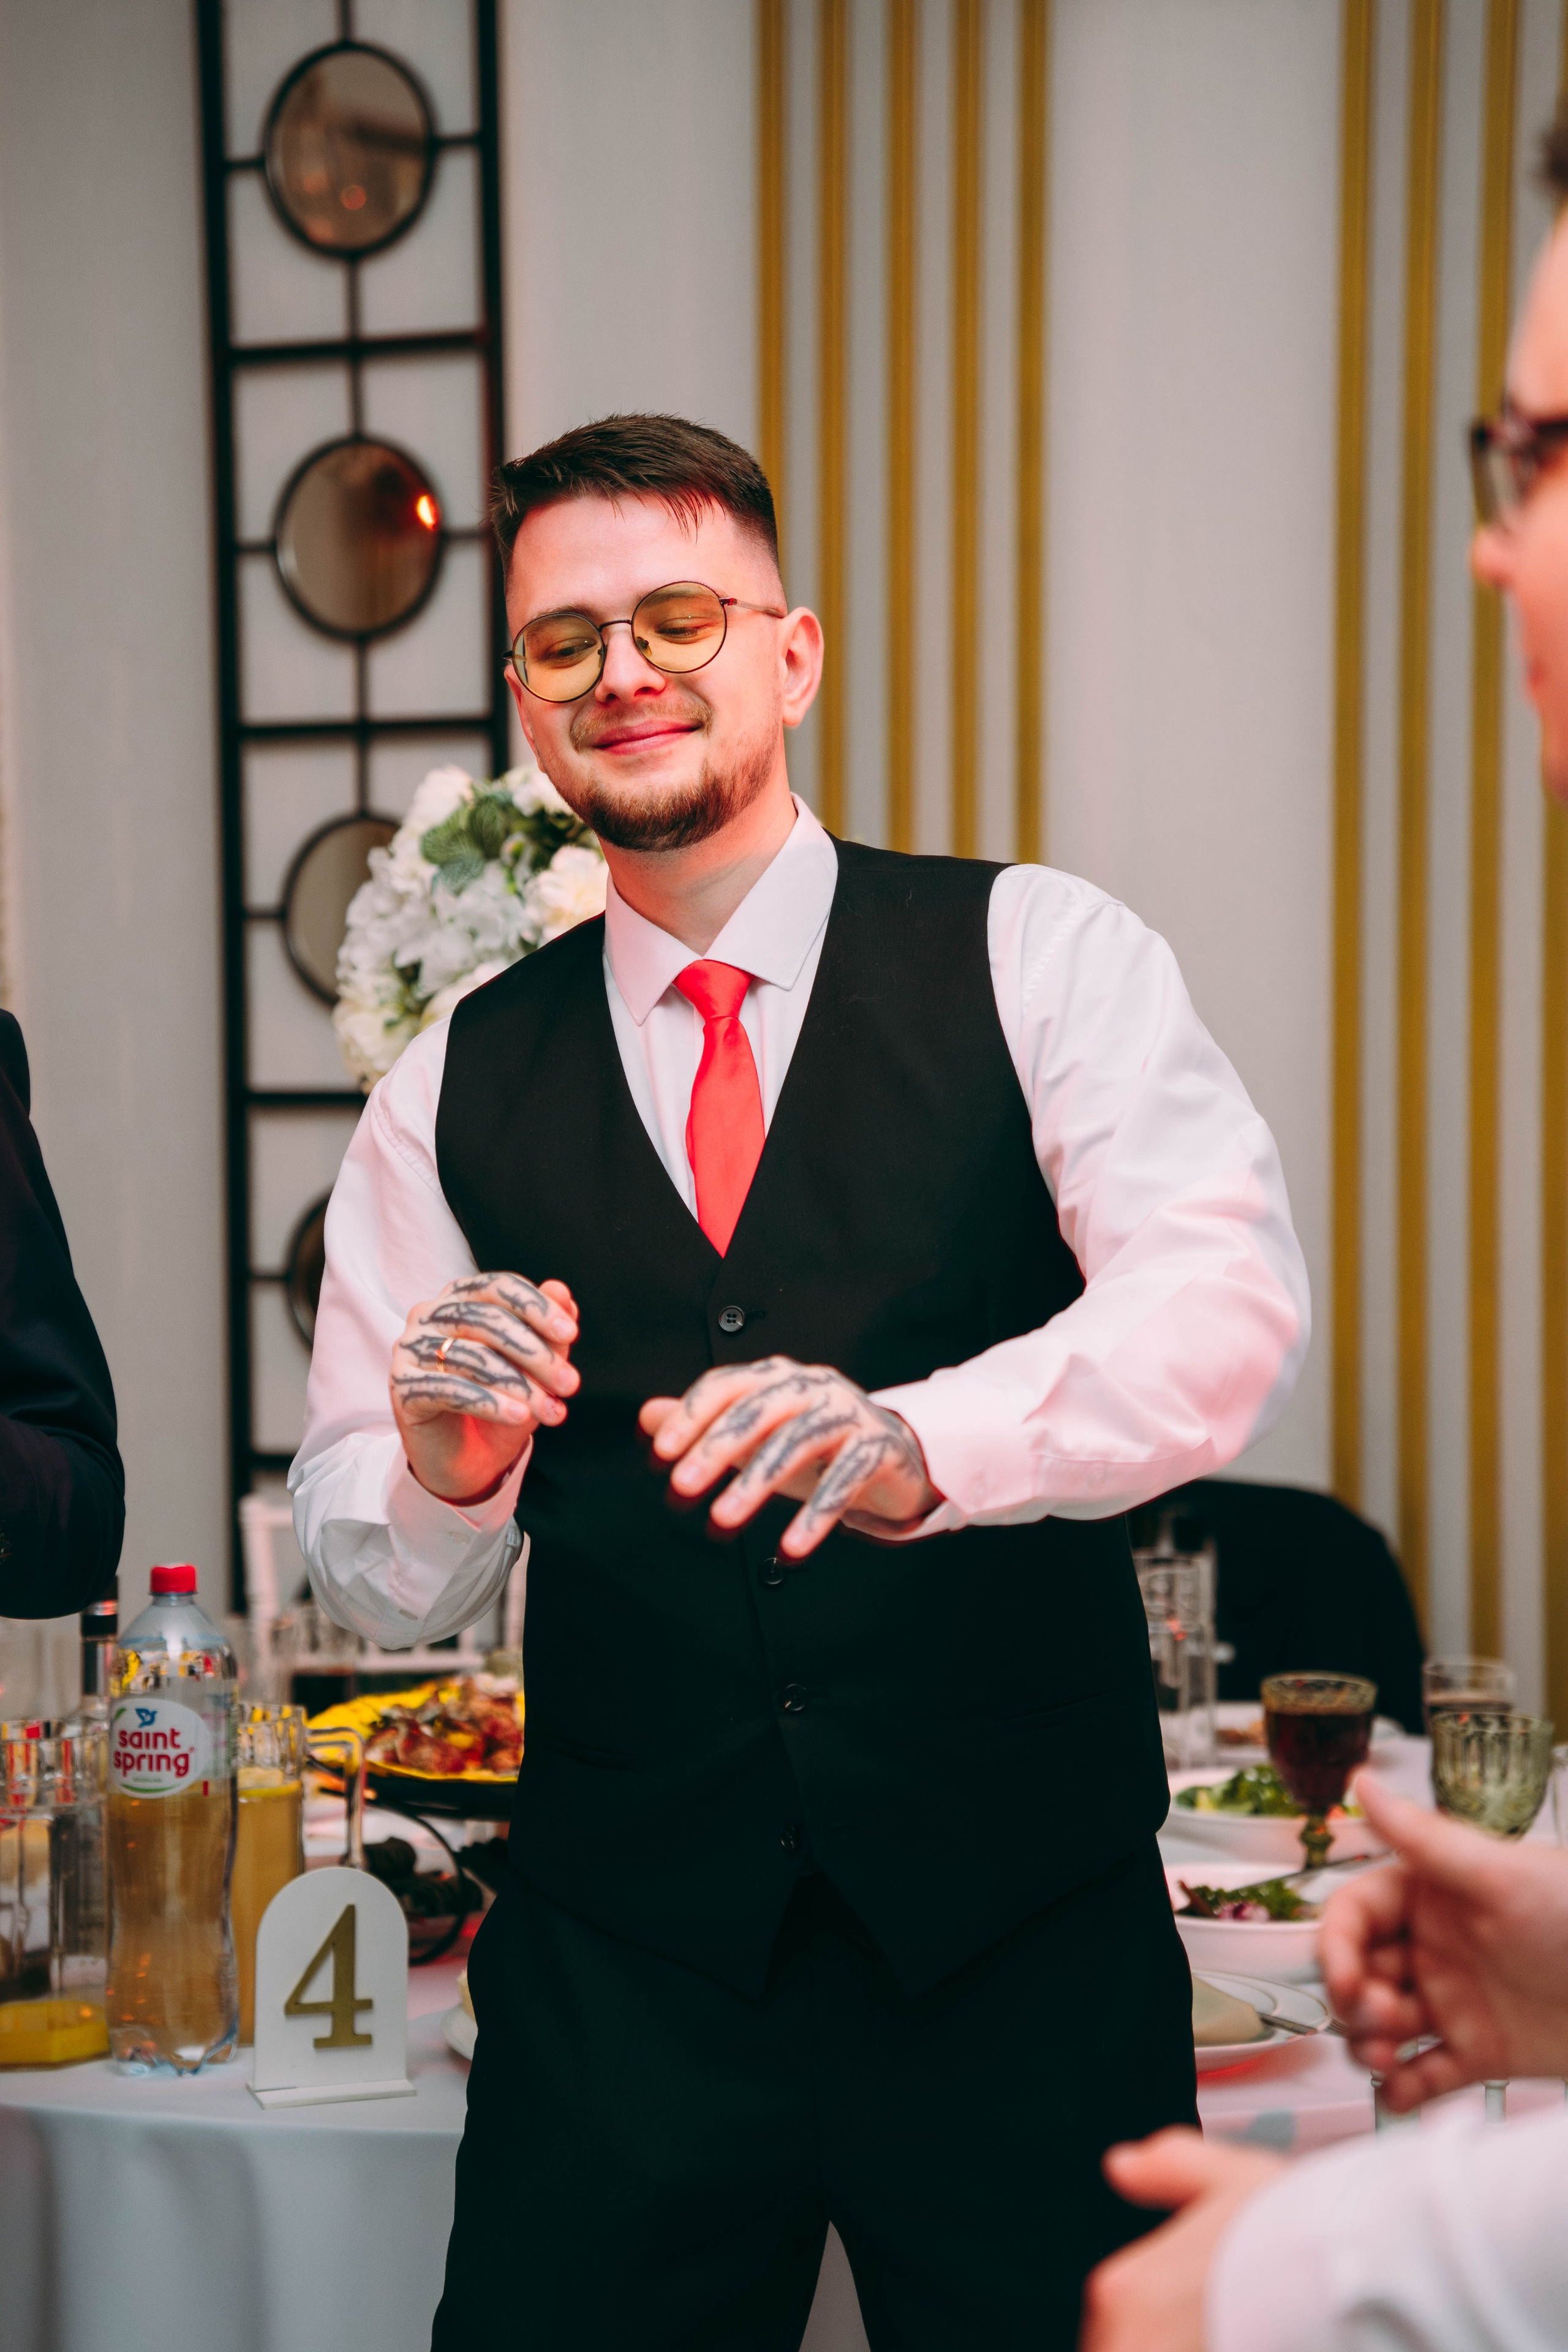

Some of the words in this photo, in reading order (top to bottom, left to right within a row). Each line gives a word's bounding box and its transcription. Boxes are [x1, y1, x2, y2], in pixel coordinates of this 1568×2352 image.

[118, 1728, 181, 1750] saint
[113, 1750, 190, 1779] spring
[284, 1903, 374, 2049] 4
